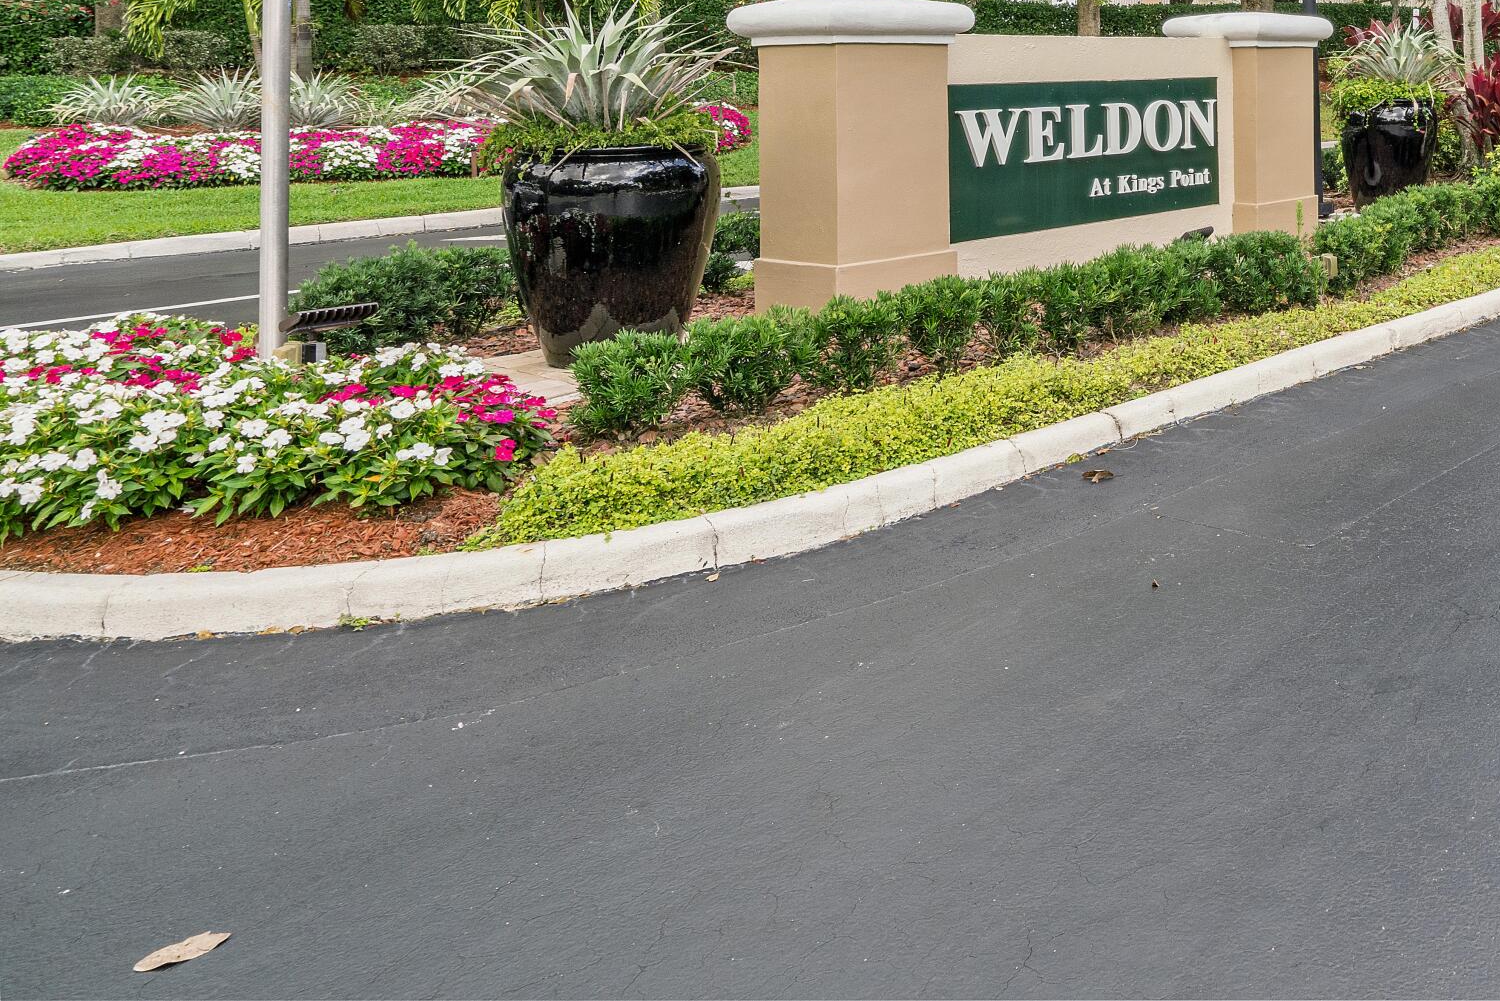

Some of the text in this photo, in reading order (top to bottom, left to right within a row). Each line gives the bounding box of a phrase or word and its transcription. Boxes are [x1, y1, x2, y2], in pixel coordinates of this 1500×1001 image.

[954, 98, 1218, 168] WELDON
[1089, 168, 1211, 197] At Kings Point
